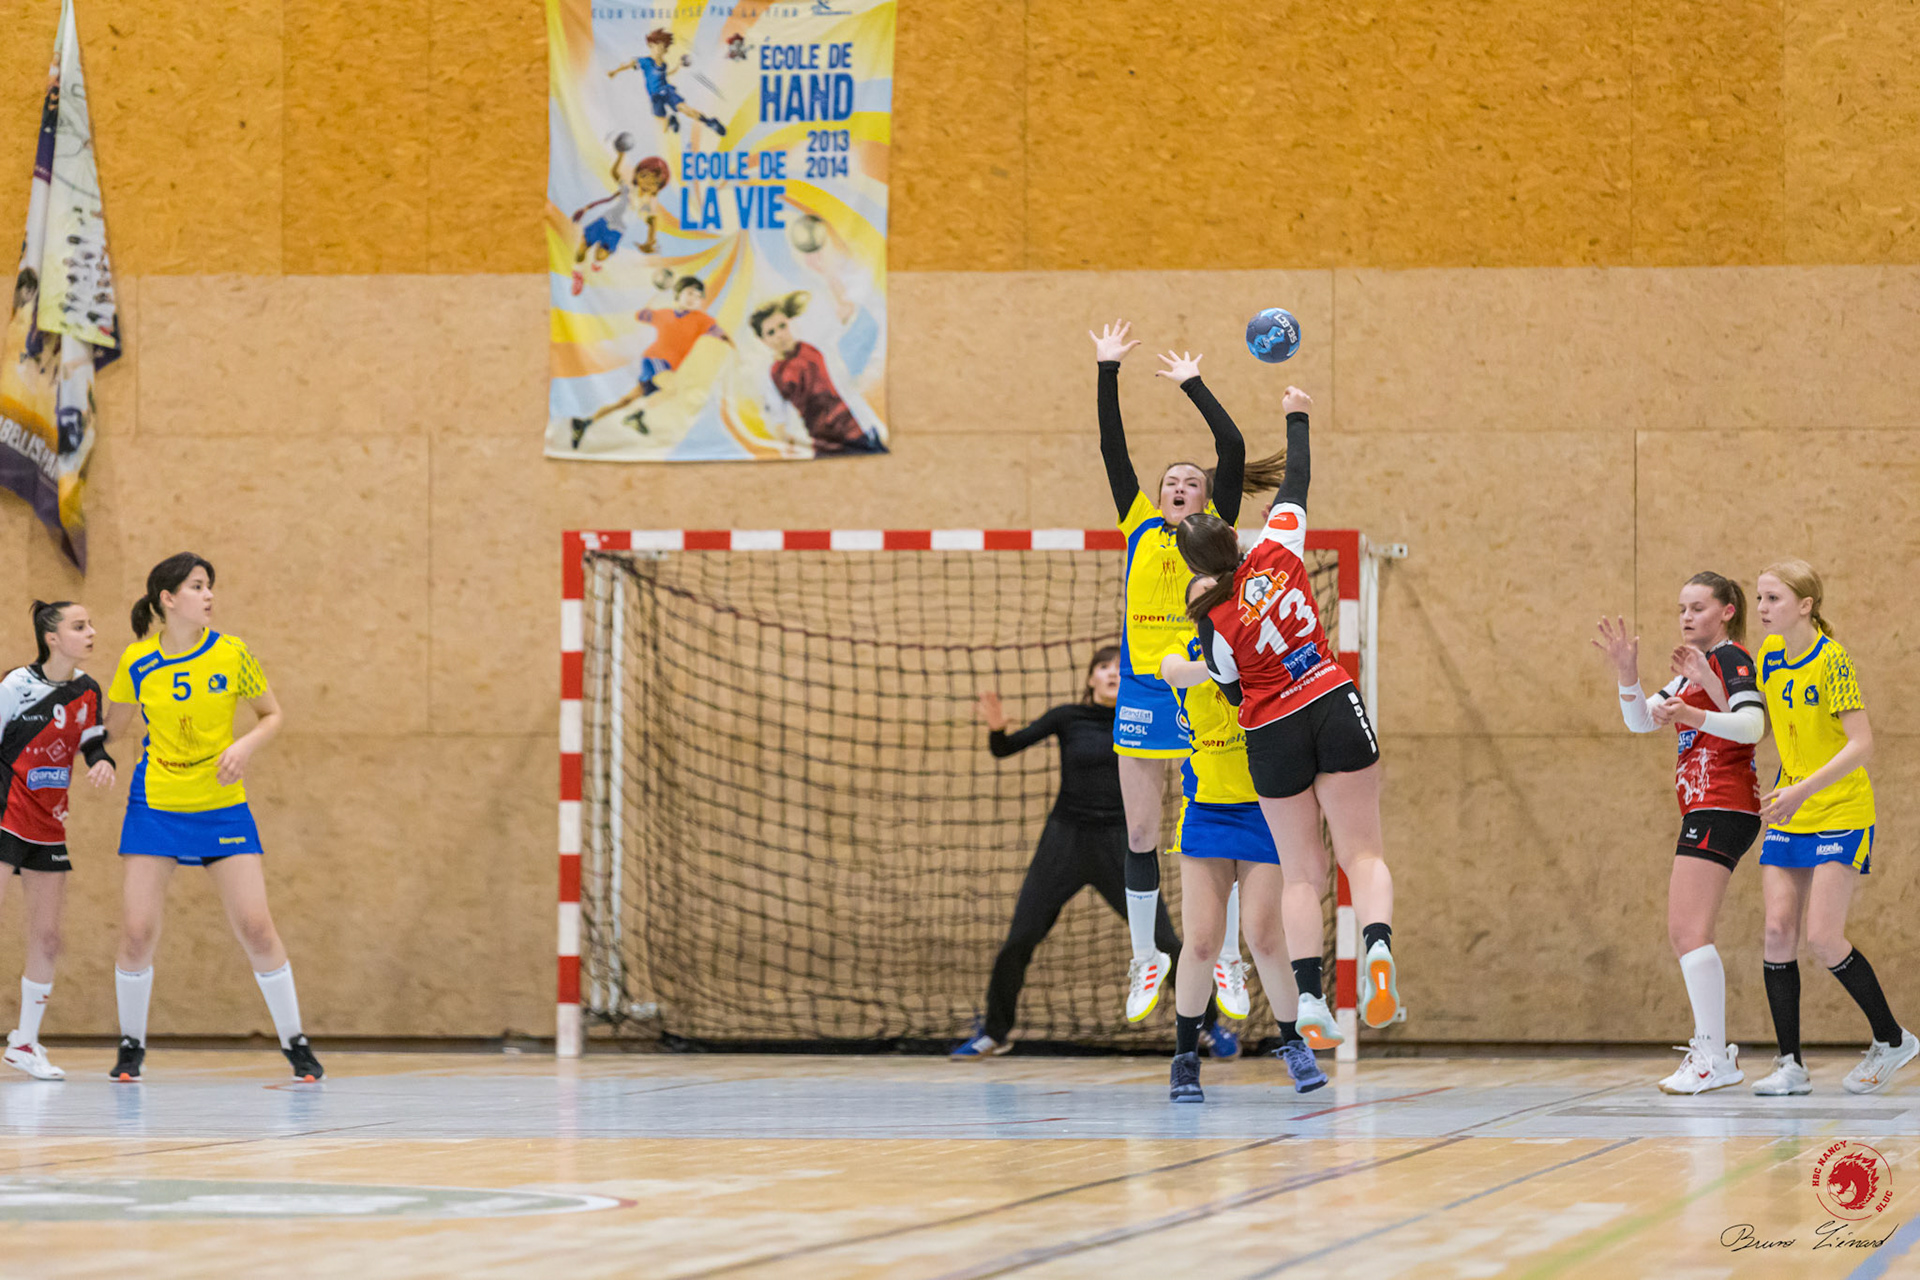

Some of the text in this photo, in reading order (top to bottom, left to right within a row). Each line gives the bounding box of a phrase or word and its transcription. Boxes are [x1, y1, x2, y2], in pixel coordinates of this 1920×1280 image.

[760, 36, 853, 70] ÉCOLE DE
[760, 73, 854, 122] HAND
[807, 130, 850, 152] 2013
[759, 151, 787, 180] DE
[806, 155, 849, 178] 2014
[680, 185, 786, 230] LA VIE
[1274, 313, 1298, 344] SELECT
[1255, 588, 1317, 655] 13
[172, 671, 192, 702] 5
[1782, 679, 1794, 709] 4
[53, 703, 66, 729] 9
